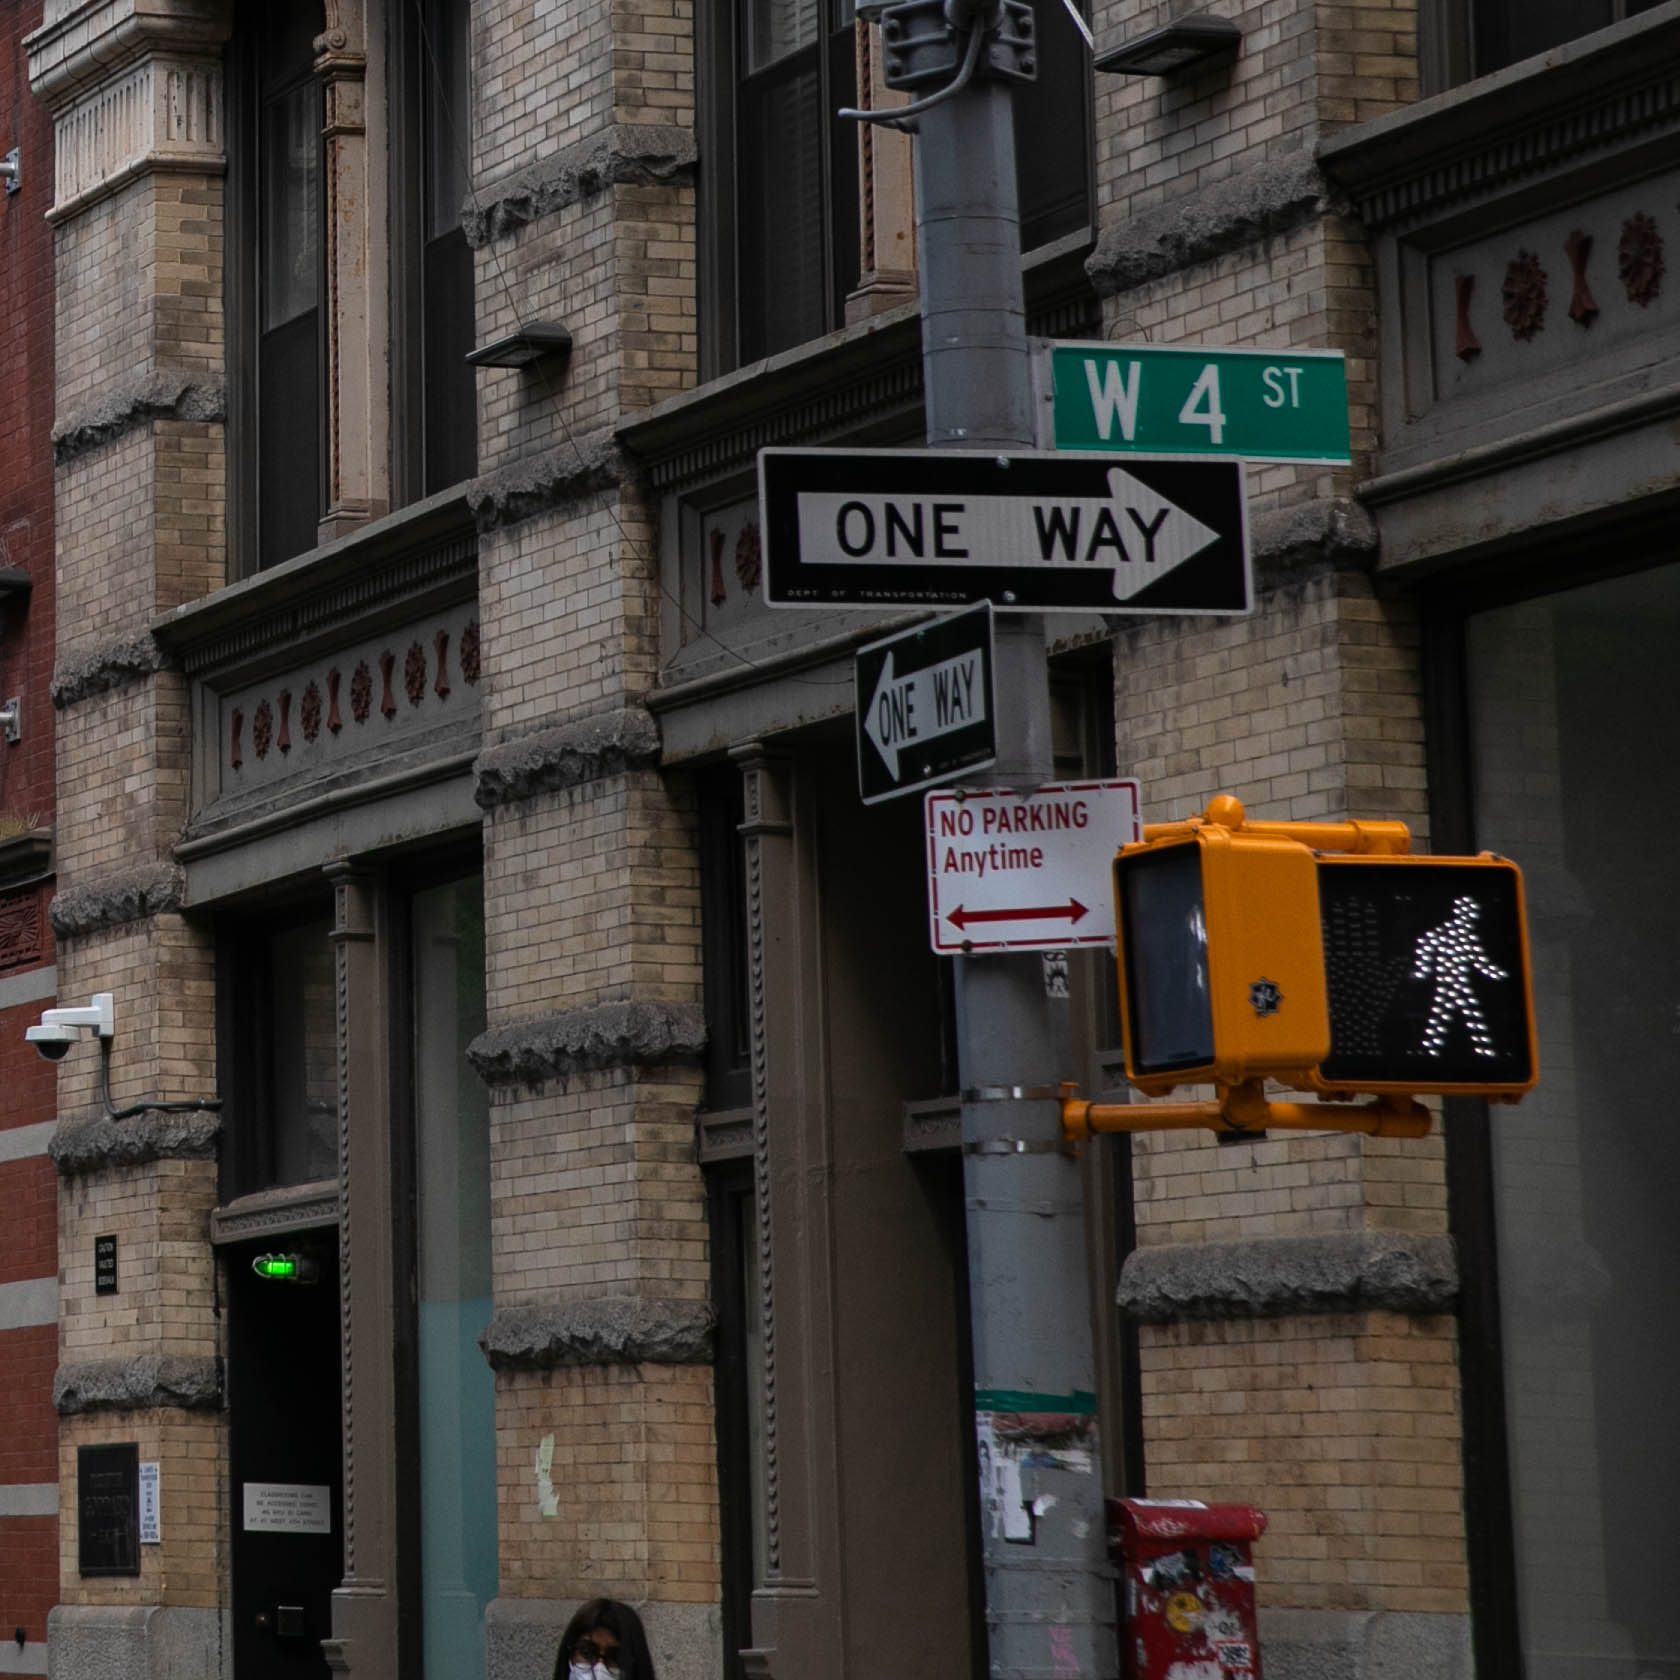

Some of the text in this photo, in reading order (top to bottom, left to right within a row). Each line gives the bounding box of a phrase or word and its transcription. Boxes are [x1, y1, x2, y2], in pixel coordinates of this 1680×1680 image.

[1084, 359, 1304, 444] W 4 ST
[836, 501, 1171, 562] ONE WAY
[860, 590, 968, 600] TRANSPORTATION
[878, 659, 975, 747] ONE WAY
[941, 800, 1089, 837] NO PARKING
[944, 842, 1044, 878] Anytime
